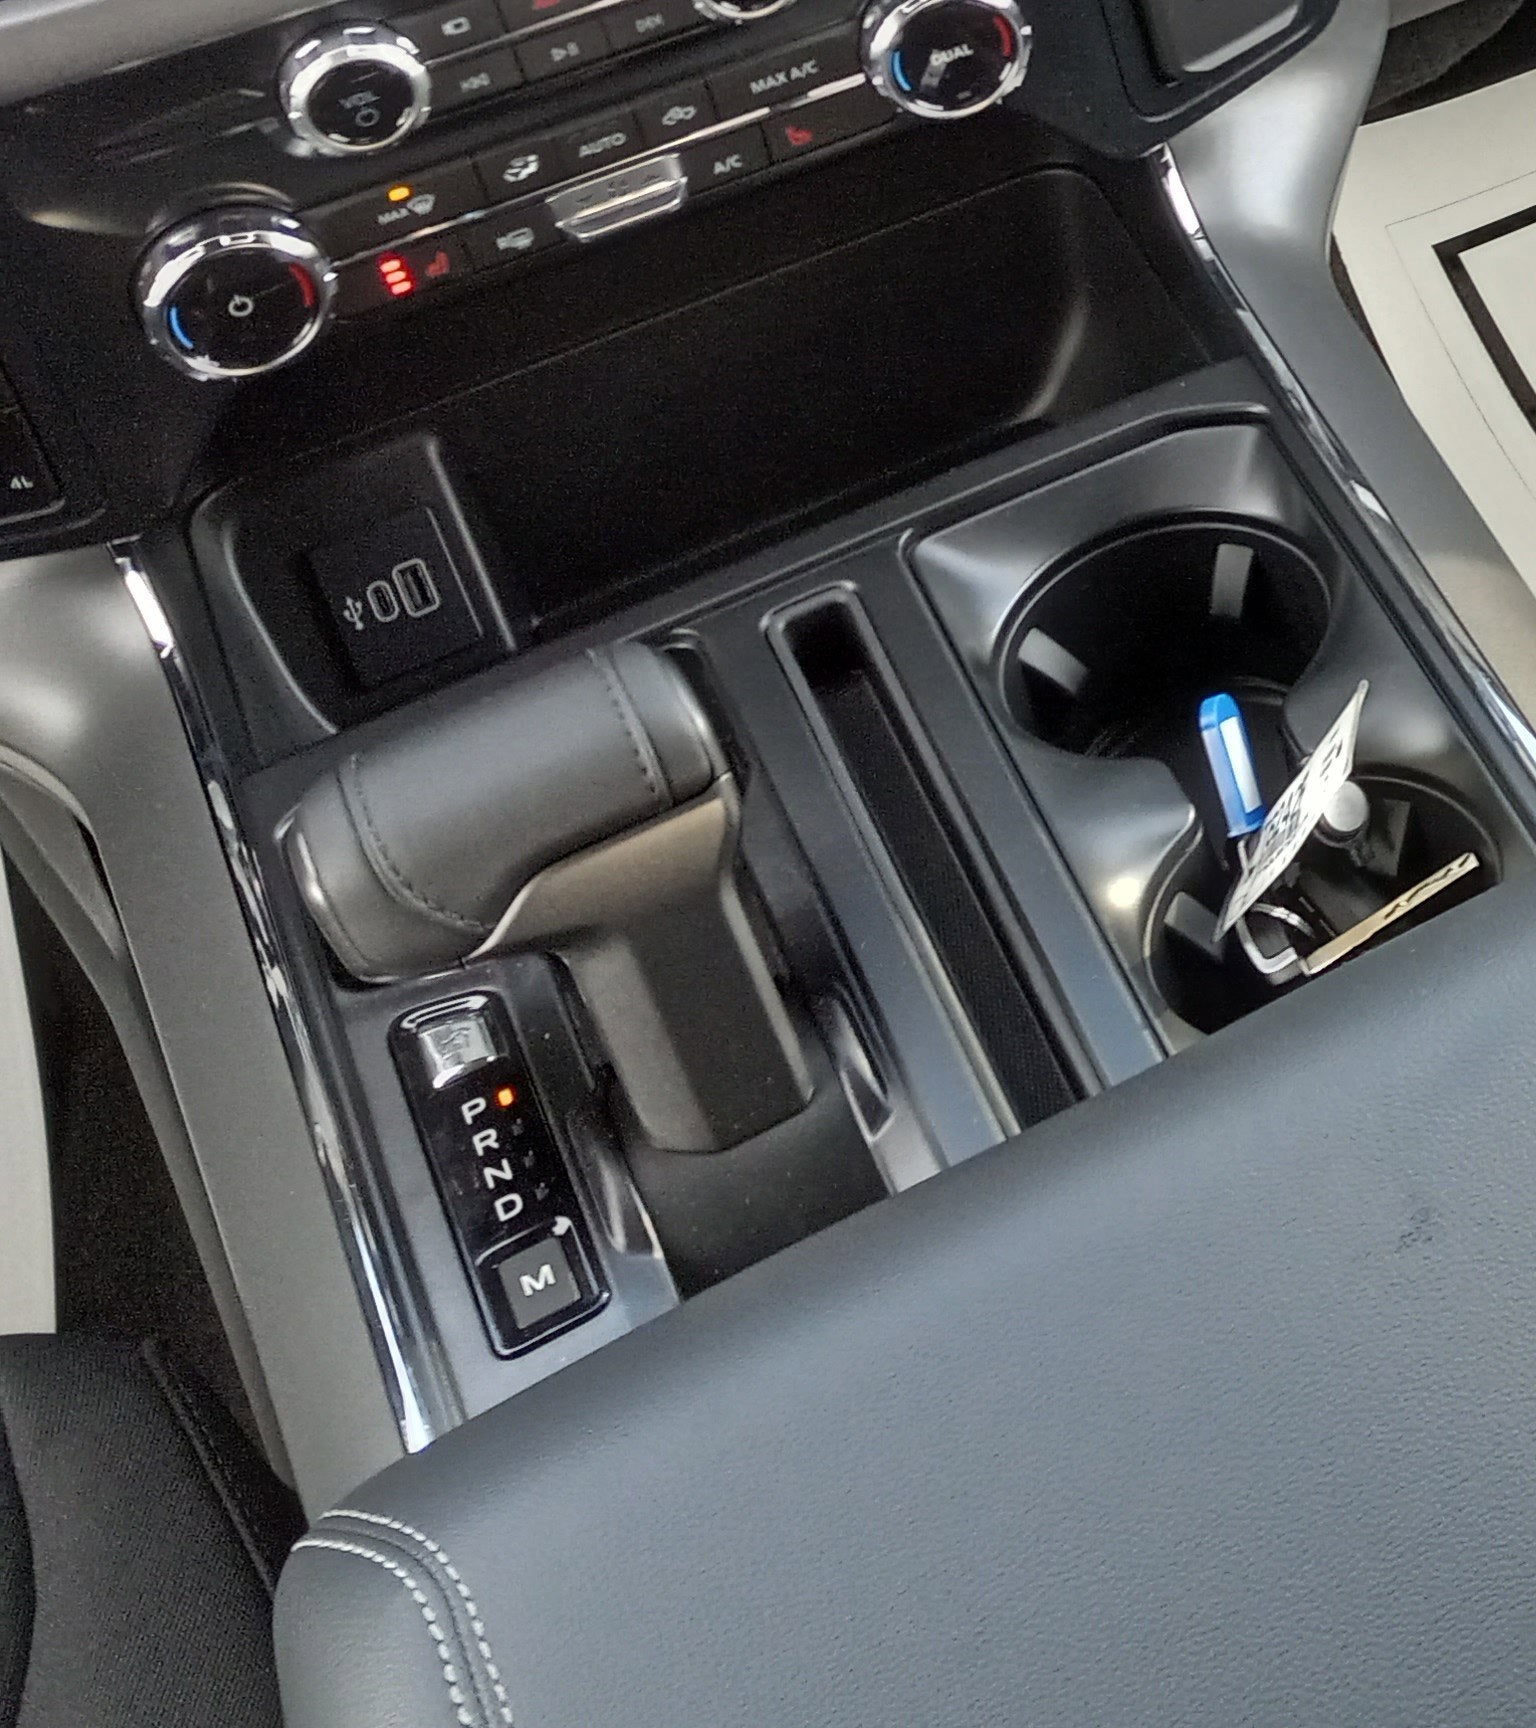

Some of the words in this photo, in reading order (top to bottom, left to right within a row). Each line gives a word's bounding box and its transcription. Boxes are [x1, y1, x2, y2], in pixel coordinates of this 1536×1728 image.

[929, 43, 975, 66] DUAL
[750, 71, 790, 95] MAX
[789, 58, 820, 83] A/C
[578, 132, 627, 158] AUTO
[712, 153, 743, 176] A/C
[377, 207, 410, 224] MAX
[461, 1096, 487, 1126] P
[472, 1127, 500, 1158] R
[483, 1158, 514, 1190] N
[494, 1192, 524, 1223] D
[519, 1263, 557, 1297] M
